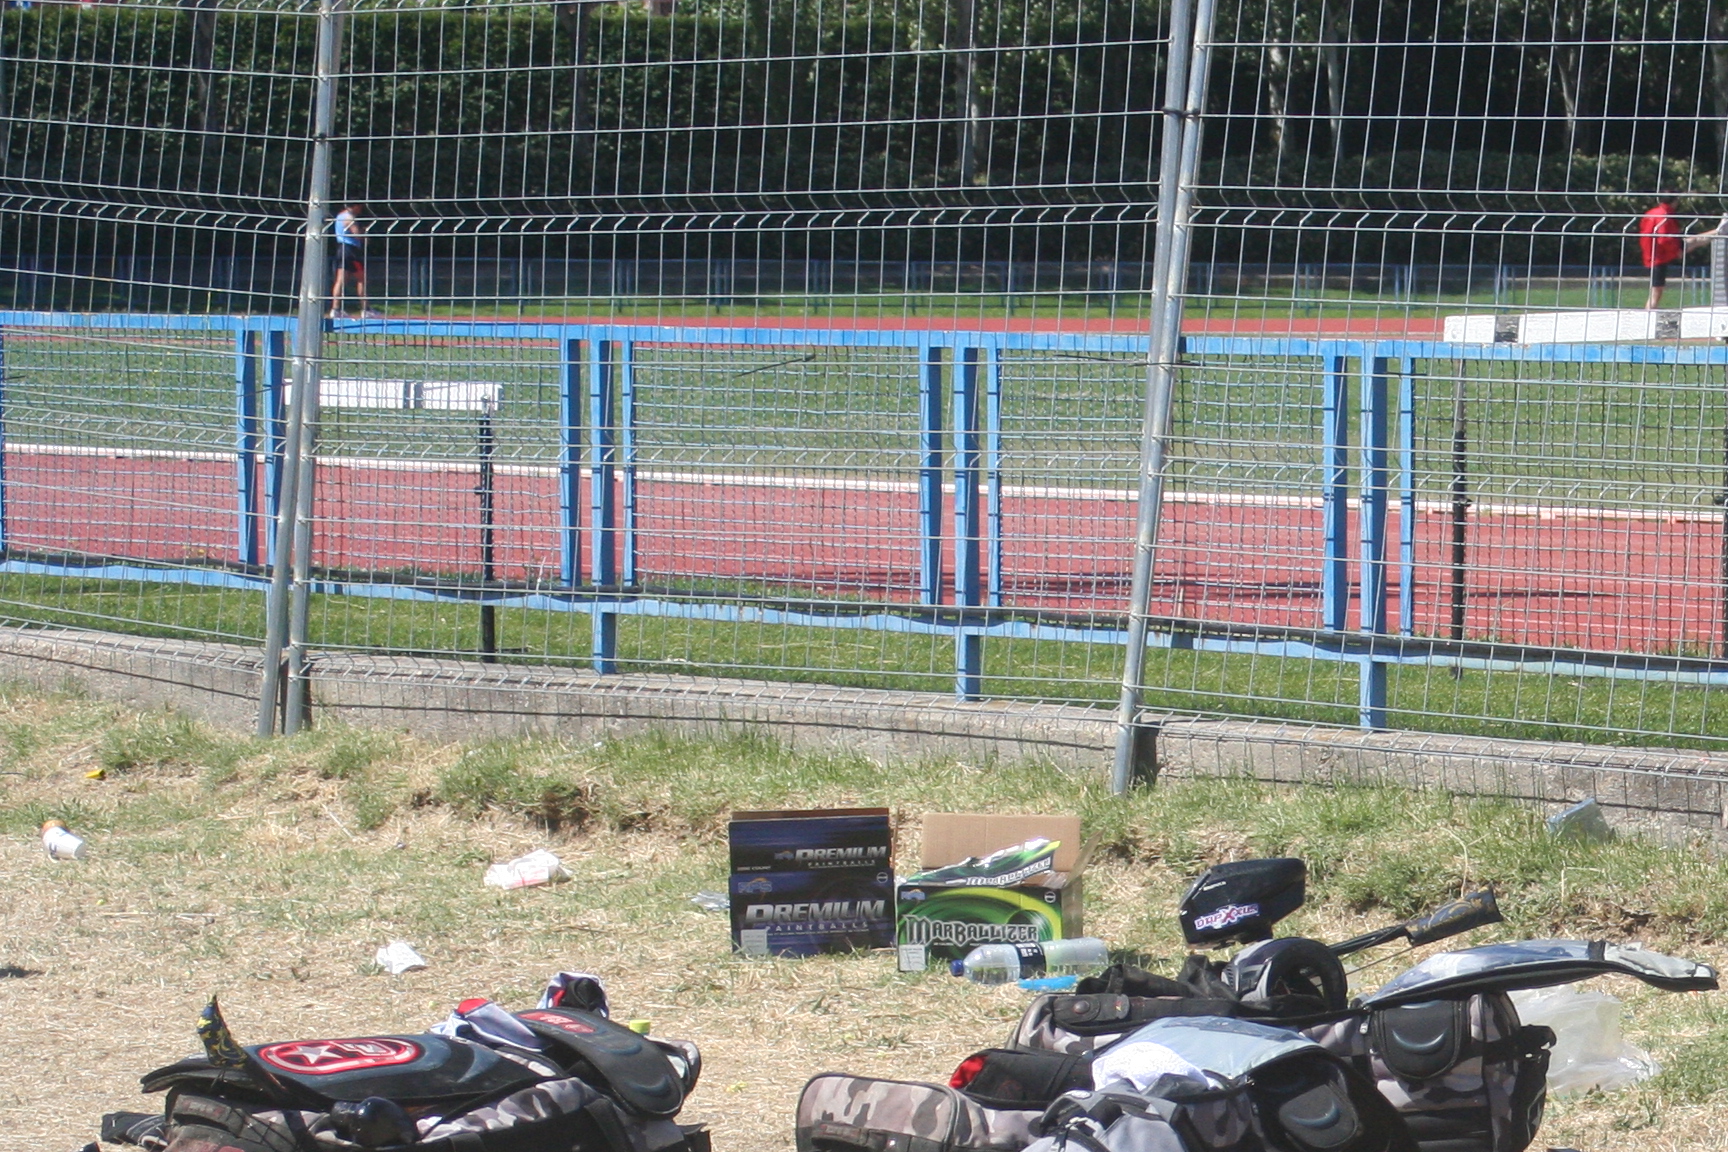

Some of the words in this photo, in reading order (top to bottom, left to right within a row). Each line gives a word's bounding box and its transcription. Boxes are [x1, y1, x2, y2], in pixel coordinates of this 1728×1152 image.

[795, 846, 887, 861] PREMIUM
[745, 900, 885, 927] PREMIUM
[765, 921, 869, 932] PAINTBALLS
